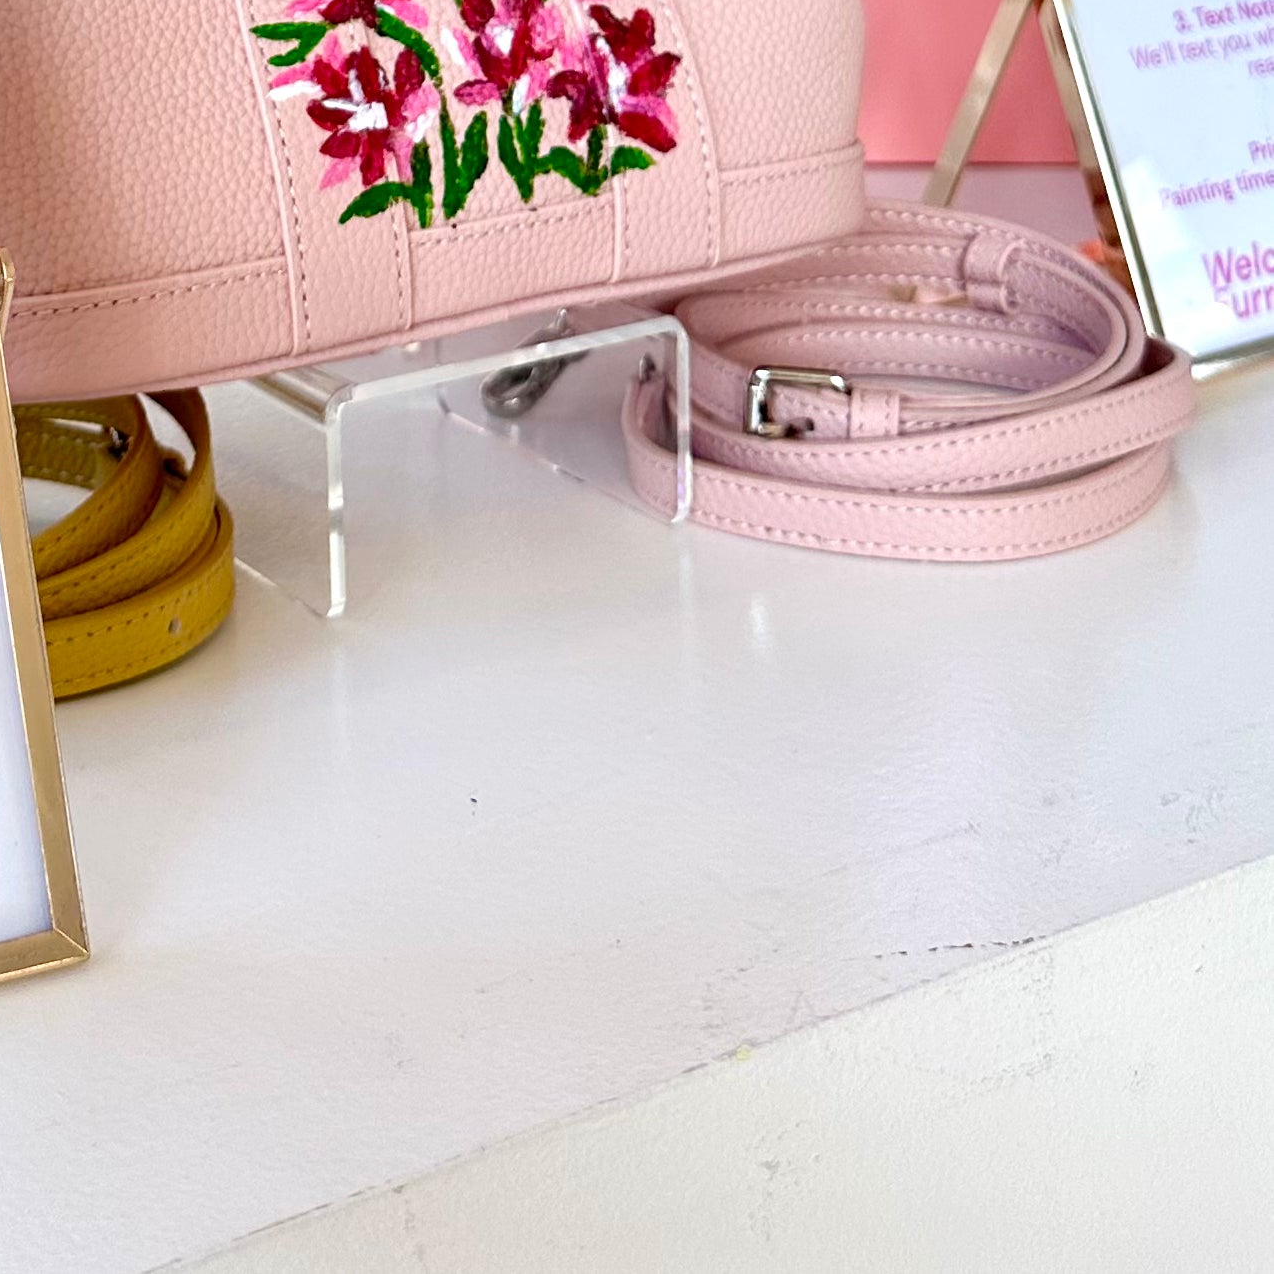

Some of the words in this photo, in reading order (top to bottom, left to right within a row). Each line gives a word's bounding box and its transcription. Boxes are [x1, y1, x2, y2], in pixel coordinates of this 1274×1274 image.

[1192, 3, 1235, 29] Text
[1178, 37, 1216, 63] text
[1217, 32, 1252, 61] you
